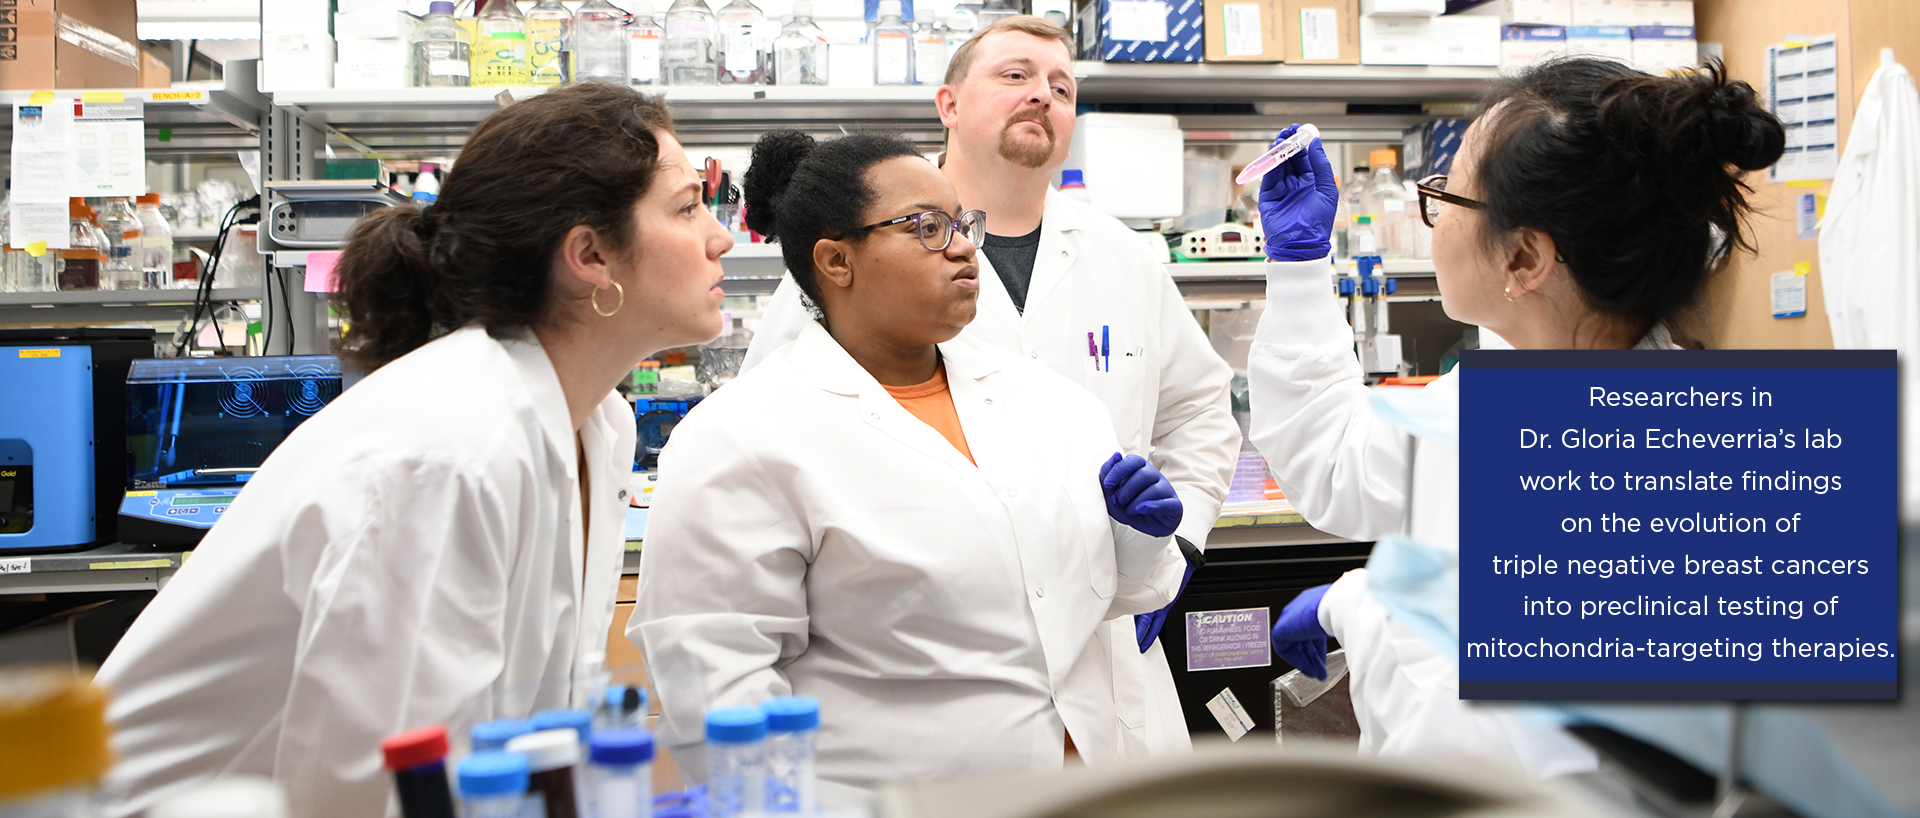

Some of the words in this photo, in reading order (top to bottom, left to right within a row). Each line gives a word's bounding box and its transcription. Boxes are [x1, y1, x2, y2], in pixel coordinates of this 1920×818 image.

[152, 92, 180, 100] BENCH
[1205, 613, 1253, 624] CAUTION
[1208, 635, 1226, 643] DRINK
[1226, 634, 1252, 642] ALLOWED
[1202, 643, 1241, 651] REFRIGERATOR
[1245, 641, 1267, 649] FREEZER
